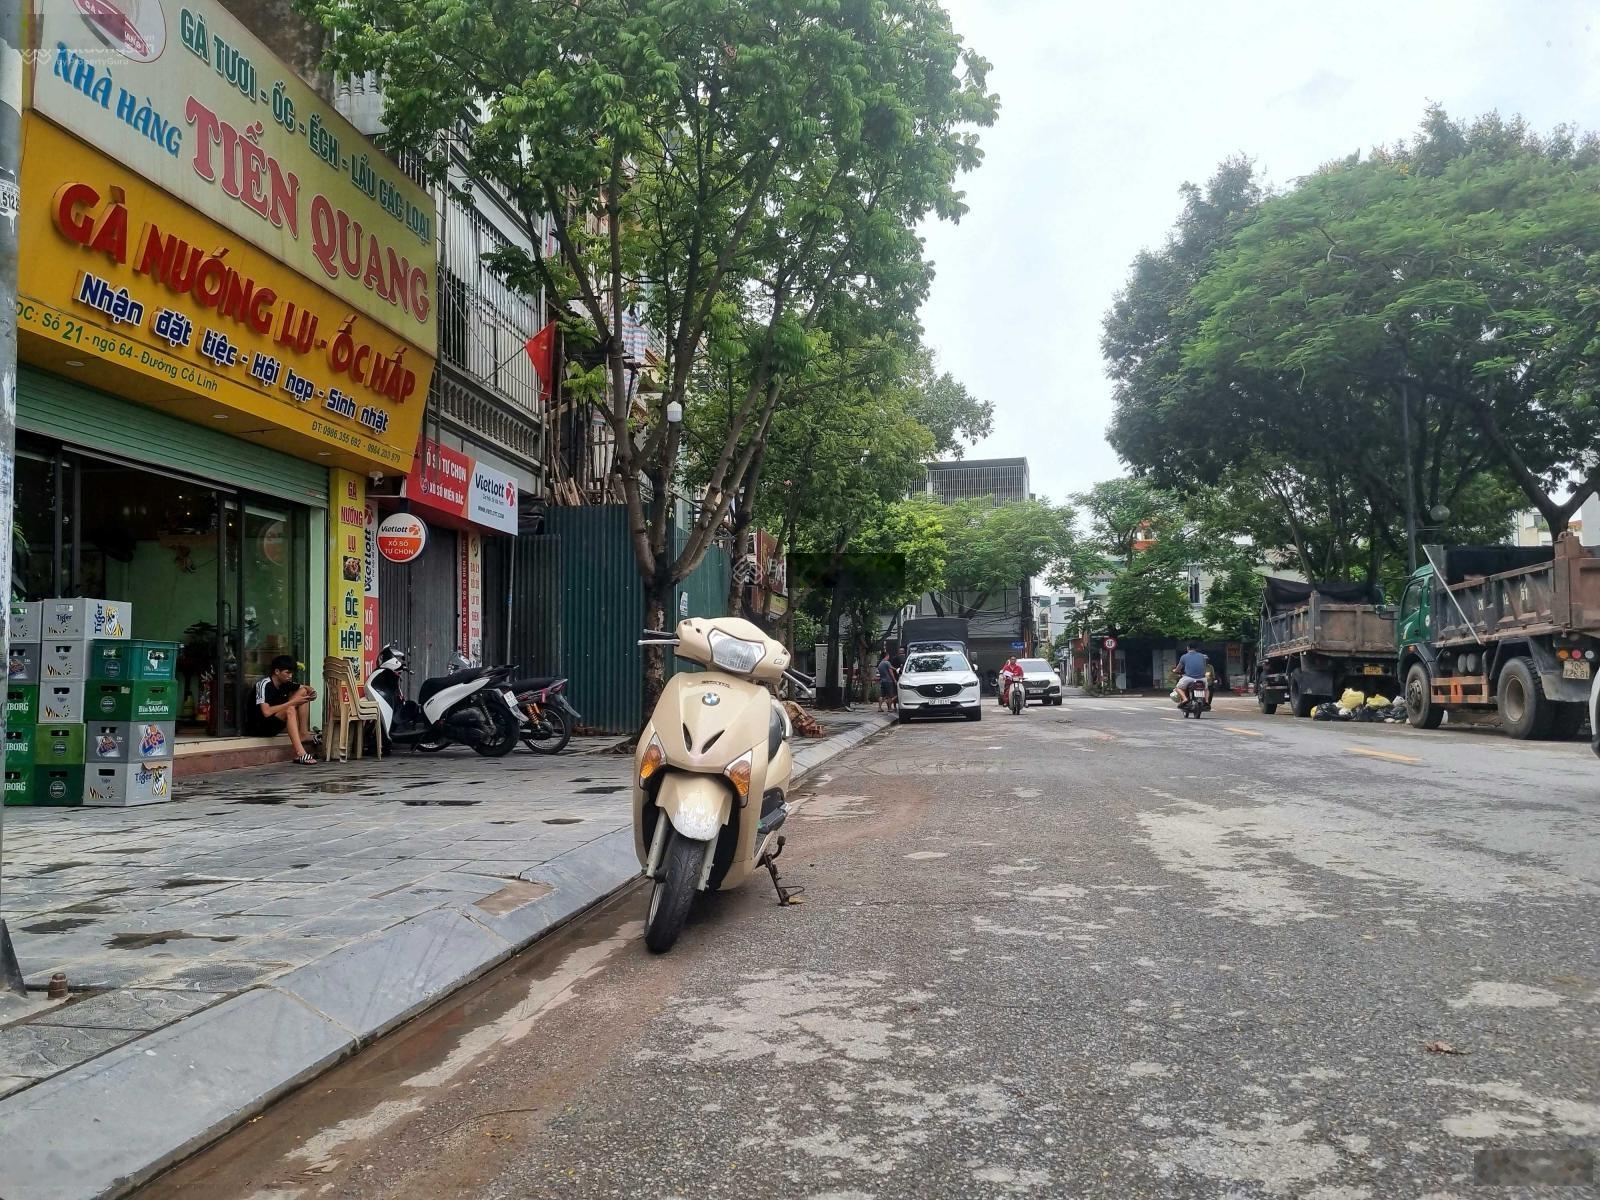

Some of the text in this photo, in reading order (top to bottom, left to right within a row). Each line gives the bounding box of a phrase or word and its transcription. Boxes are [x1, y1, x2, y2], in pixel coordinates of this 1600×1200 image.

[53, 41, 182, 158] NHÀ HÀNG
[180, 8, 210, 64] GÀ
[212, 32, 257, 102] TƯƠI
[351, 153, 377, 199] LẨU
[378, 176, 404, 223] CÁC
[405, 200, 432, 246] LOẠI
[185, 95, 430, 323] TIẾN QUANG
[56, 182, 128, 265] GÀ
[136, 222, 278, 336] NƯỚNG
[42, 312, 60, 331] Số
[62, 321, 83, 344] 21
[92, 334, 116, 354] ngõ
[119, 342, 134, 358] 64
[141, 351, 178, 379] Đường
[196, 371, 219, 392] Linh
[80, 271, 145, 327] Nhận
[154, 307, 195, 348] đặt
[201, 327, 239, 367] tiệc
[251, 352, 281, 387] Hội
[284, 367, 315, 403] họp
[326, 387, 357, 420] Sinh
[360, 404, 390, 435] nhật
[450, 462, 467, 483] CHỌN
[475, 472, 505, 498] Vietlott
[381, 525, 408, 533] Vietlott
[57, 613, 72, 623] Tiger
[94, 603, 104, 633] Tiger
[134, 772, 152, 784] Tiger
